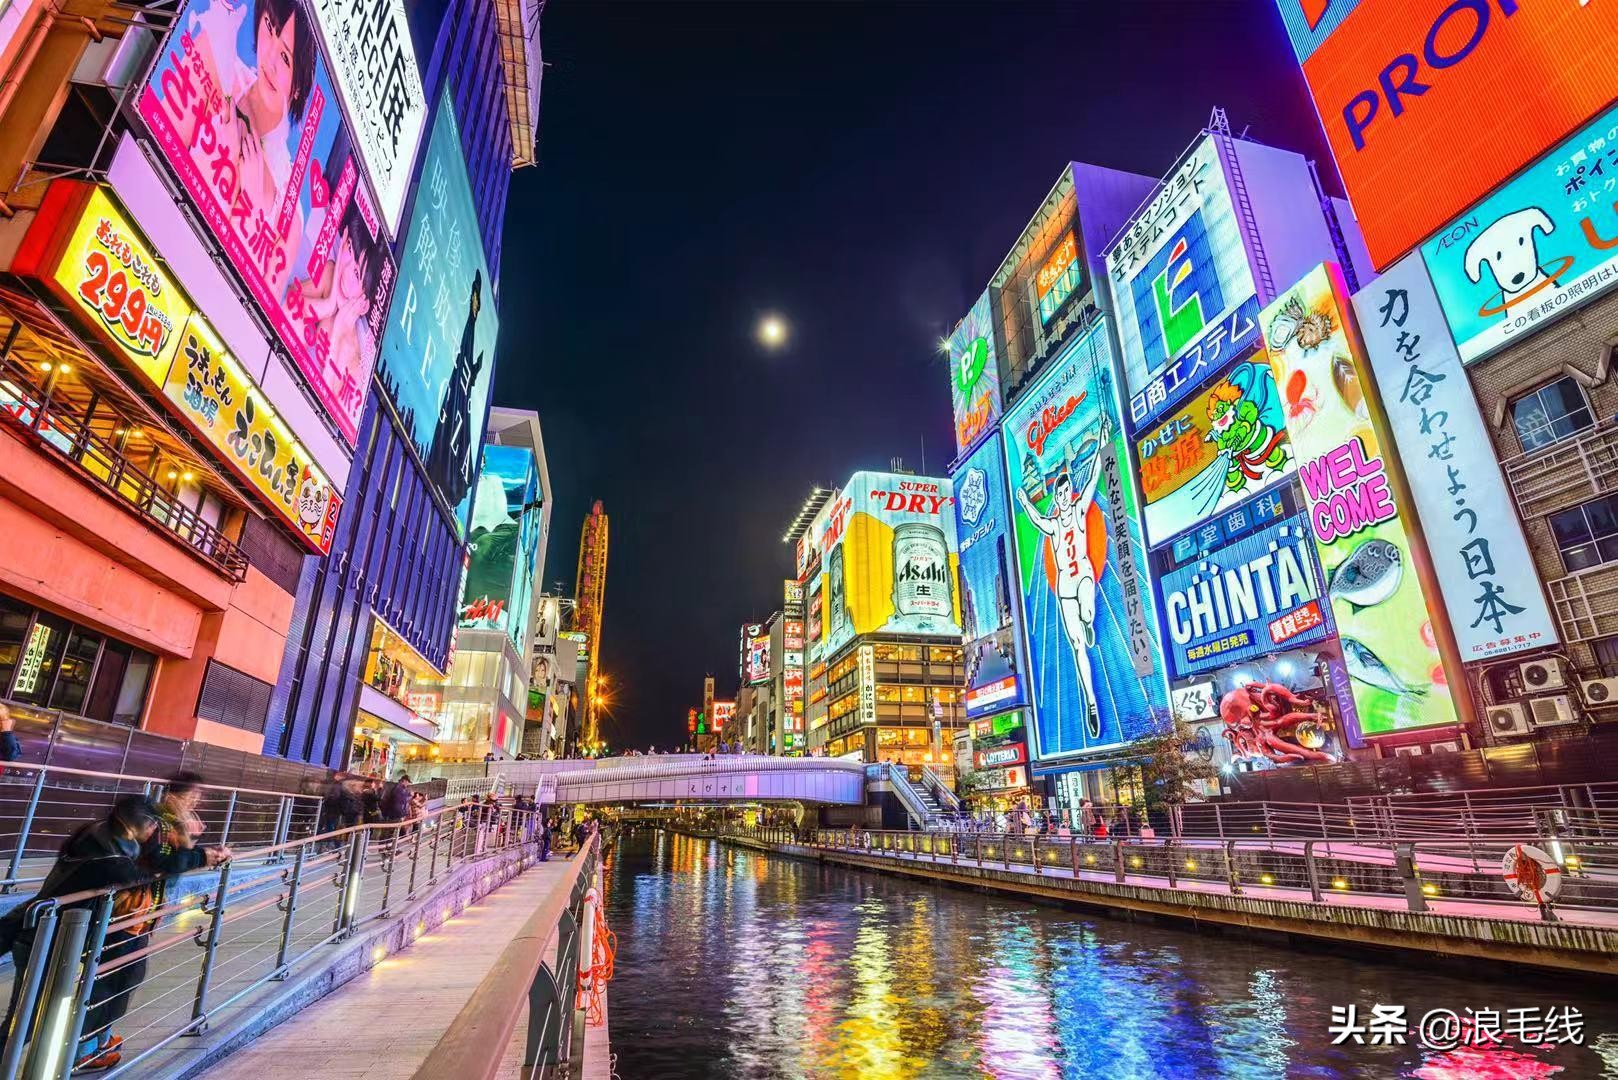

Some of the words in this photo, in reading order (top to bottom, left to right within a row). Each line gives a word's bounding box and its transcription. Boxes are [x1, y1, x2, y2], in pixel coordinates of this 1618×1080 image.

[351, 0, 384, 100] PIECE
[1343, 0, 1519, 152] PRO
[313, 175, 324, 202] VS
[356, 188, 378, 238] NMB48
[1112, 157, 1198, 263] 夢あるマンション
[1115, 177, 1206, 282] エステムコート
[81, 251, 164, 354] 299円
[184, 335, 232, 406] うまいもん
[401, 281, 471, 484] REGZA
[961, 340, 978, 386] P!
[1131, 312, 1257, 423] 日商エステム
[184, 372, 219, 428] 酒場
[1026, 390, 1087, 457] Glico
[228, 396, 299, 505] えこひいき
[1140, 428, 1203, 494] 改源
[1141, 413, 1195, 459] かぜに
[1379, 289, 1527, 634] 力を合わせよう日本
[899, 481, 938, 493] SUPER
[1300, 439, 1382, 500] WEL
[322, 503, 338, 546] 2F
[1313, 474, 1395, 542] COME
[899, 560, 945, 583] Asahi
[1064, 527, 1079, 578] グリコ
[1105, 456, 1149, 663] みんなに笑顔を届けたい。
[465, 598, 504, 623] H&M
[916, 585, 931, 596] 生
[1168, 527, 1318, 645] CHINTAI
[1187, 631, 1249, 660] 毎週水曜日発売
[1269, 616, 1298, 642] 賃貸
[1296, 613, 1320, 631] ニュース
[1472, 631, 1541, 652] 広告募集中
[1320, 662, 1331, 686] 2F
[986, 748, 1016, 766] LOTTERIA
